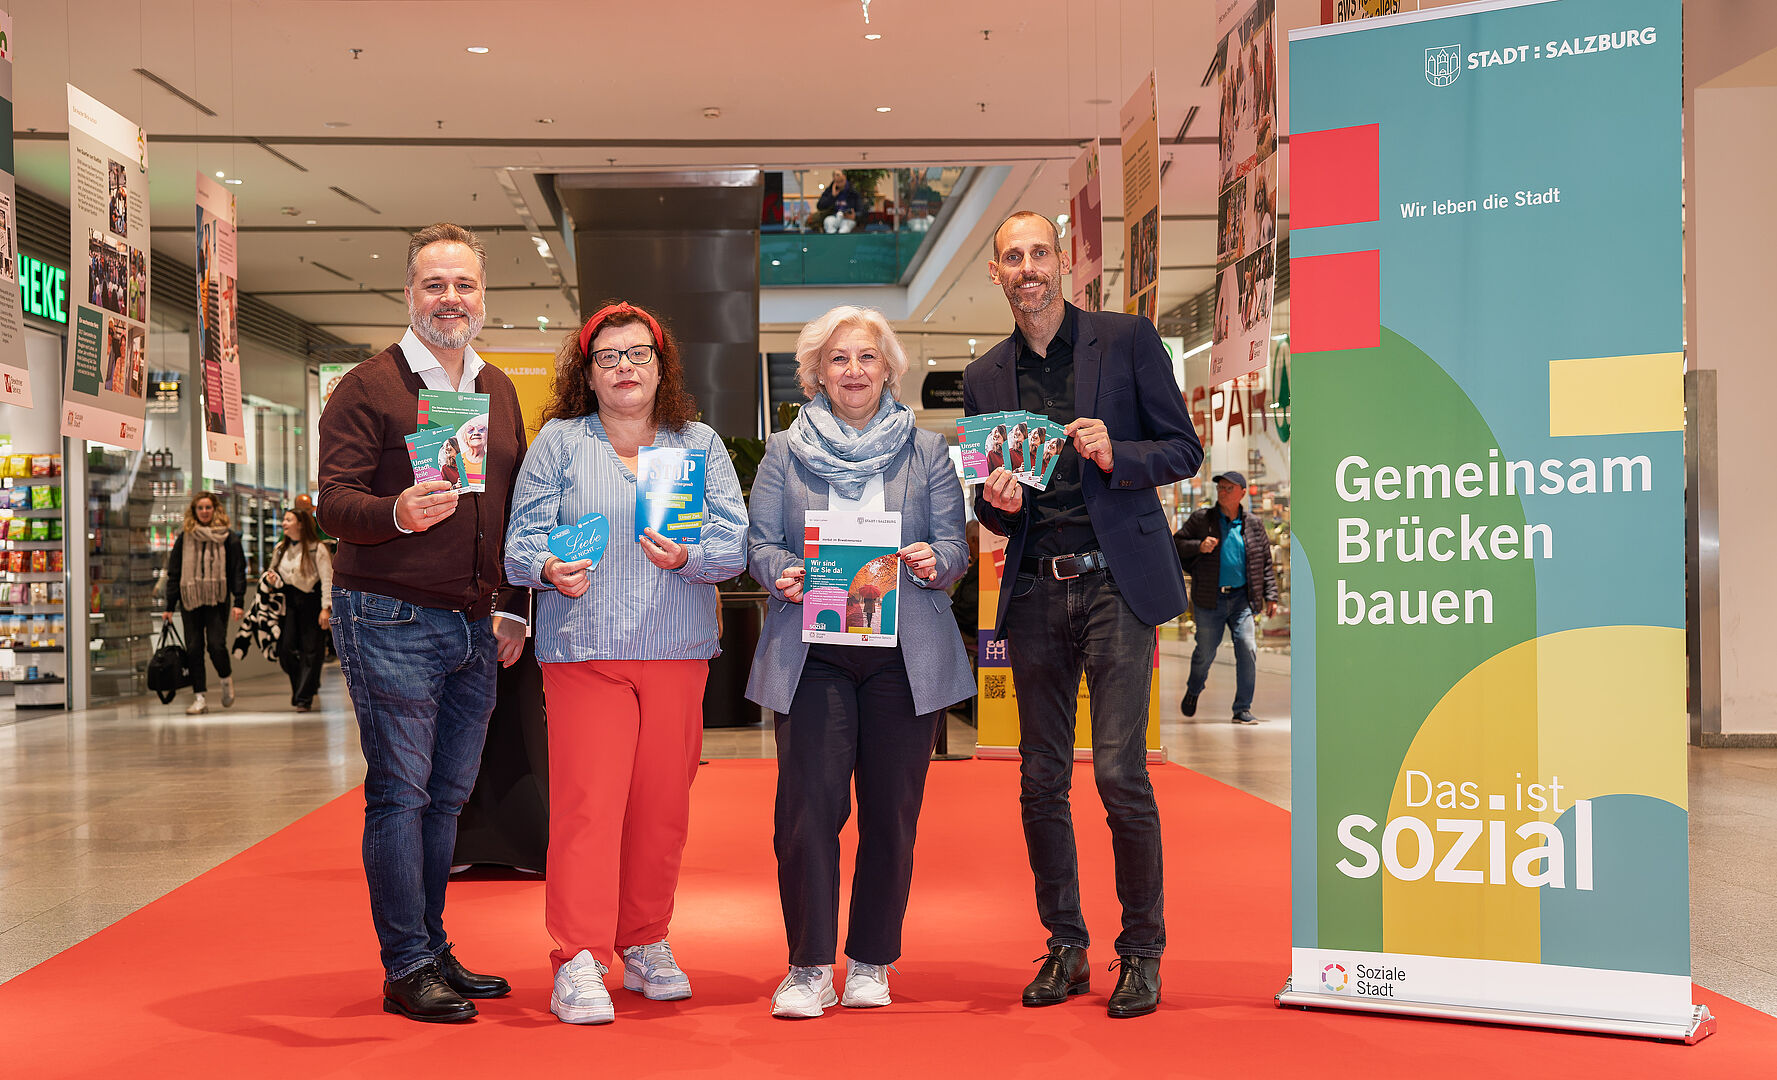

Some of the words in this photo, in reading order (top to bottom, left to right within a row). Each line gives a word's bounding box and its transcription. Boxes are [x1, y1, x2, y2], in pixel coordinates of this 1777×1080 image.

[1467, 45, 1530, 70] STADT
[1545, 26, 1657, 59] SALZBURG
[1400, 202, 1428, 219] Wir
[1432, 199, 1477, 216] leben
[1482, 193, 1509, 210] die
[1514, 187, 1561, 207] Stadt
[503, 367, 548, 376] SALZBURG
[1182, 372, 1267, 448] SPAR
[1335, 448, 1652, 503] Gemeinsam
[565, 528, 602, 556] Liebe
[1337, 513, 1553, 564] Brücken
[1337, 579, 1493, 626] bauen
[1405, 770, 1480, 810] Das
[1516, 773, 1565, 814] ist
[1336, 795, 1594, 891] sozial
[1356, 964, 1406, 982] Soziale
[1356, 980, 1394, 998] Stadt
